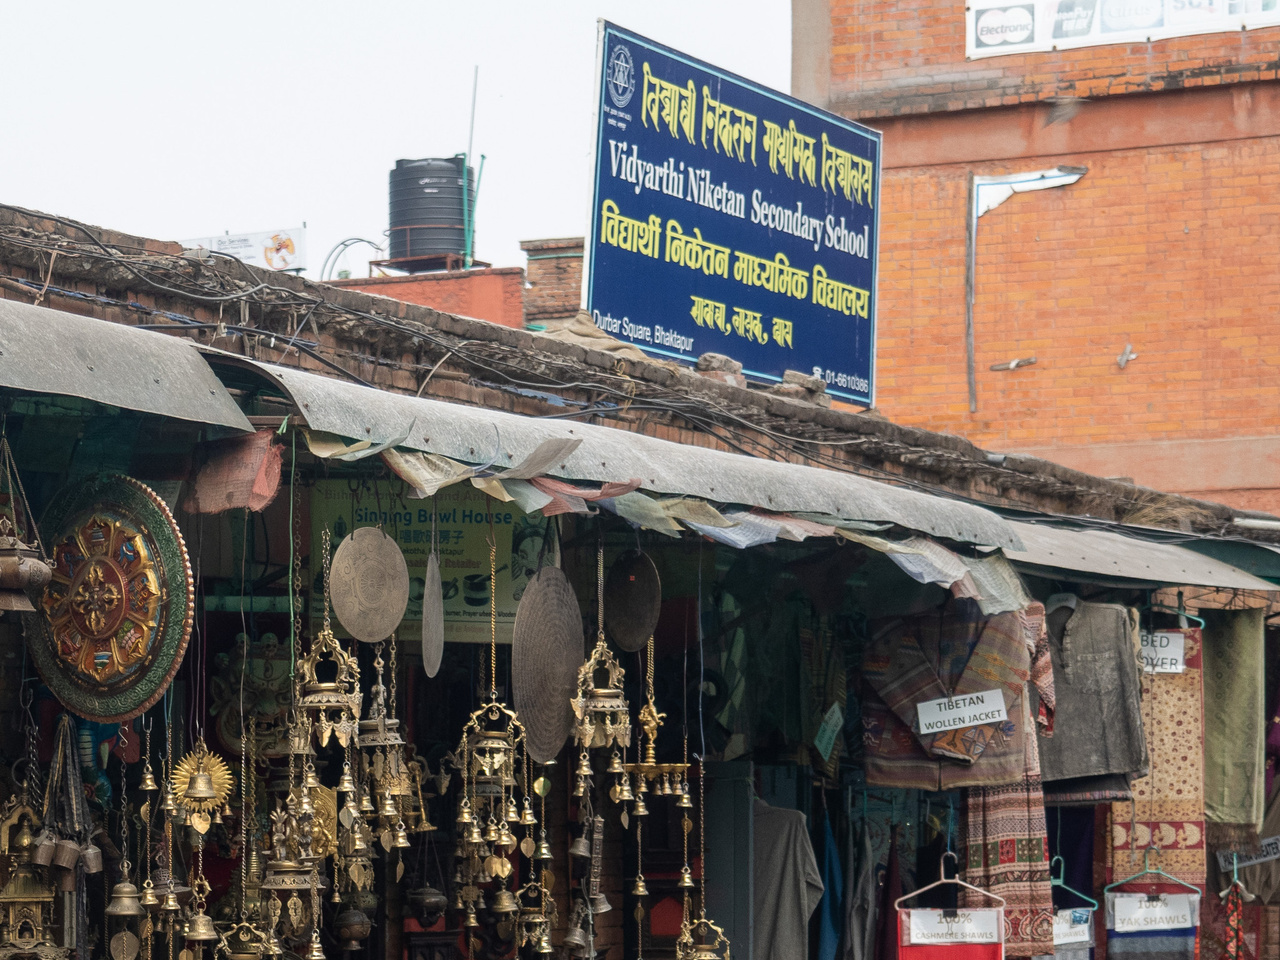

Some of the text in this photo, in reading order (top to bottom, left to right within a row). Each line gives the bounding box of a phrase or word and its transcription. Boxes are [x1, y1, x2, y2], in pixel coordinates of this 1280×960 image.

[979, 22, 1031, 36] Electronic
[608, 139, 869, 260] Vidyarthi Niketan Secondary School
[600, 199, 870, 319] विद्यार्थी निकेतन माध्यमिक विद्यालय
[593, 309, 695, 354] Durbar Square, Bhaktapur
[356, 507, 513, 526] Singing Bowl House
[1141, 634, 1170, 648] BED
[936, 695, 985, 712] TIBETAN
[924, 709, 1002, 730] WOLLEN JACKET
[1119, 914, 1188, 926] YAK SHAWLS
[915, 931, 994, 940] CASHMERE SHAWLS
